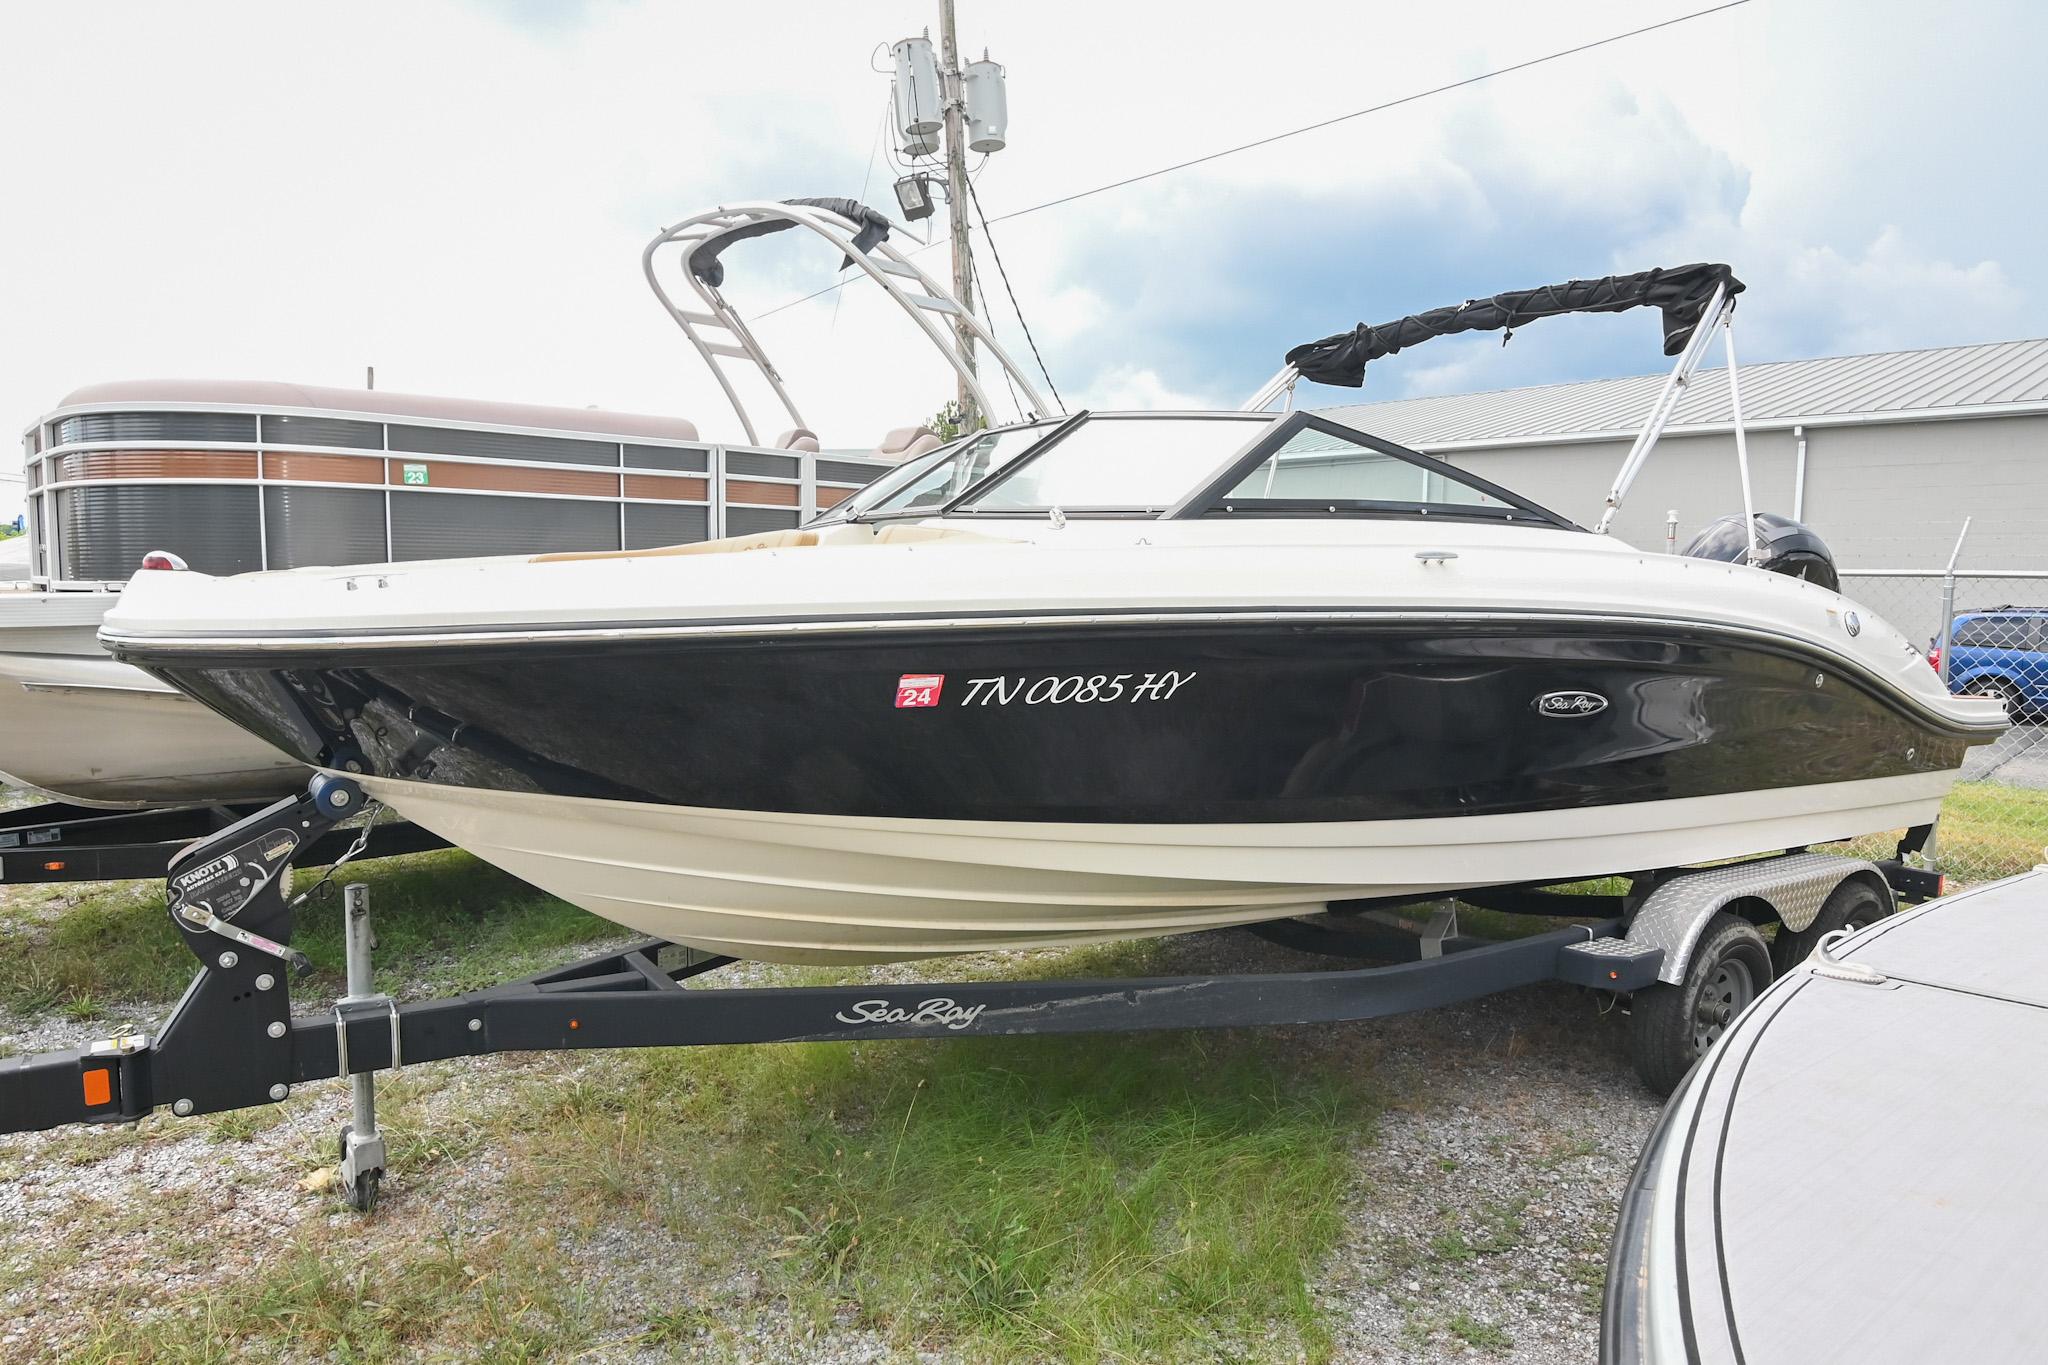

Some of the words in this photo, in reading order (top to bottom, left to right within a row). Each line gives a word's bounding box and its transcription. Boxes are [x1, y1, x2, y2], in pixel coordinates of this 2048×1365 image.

[407, 471, 425, 484] 23
[902, 688, 931, 706] 24
[960, 675, 1026, 706] TN
[1025, 673, 1134, 705] 0085
[1130, 670, 1198, 703] HY
[1545, 697, 1570, 710] Sea
[1570, 696, 1598, 713] Ray
[180, 859, 222, 887] KNOTT
[835, 1000, 914, 1024] Sea
[910, 997, 987, 1030] Ray
